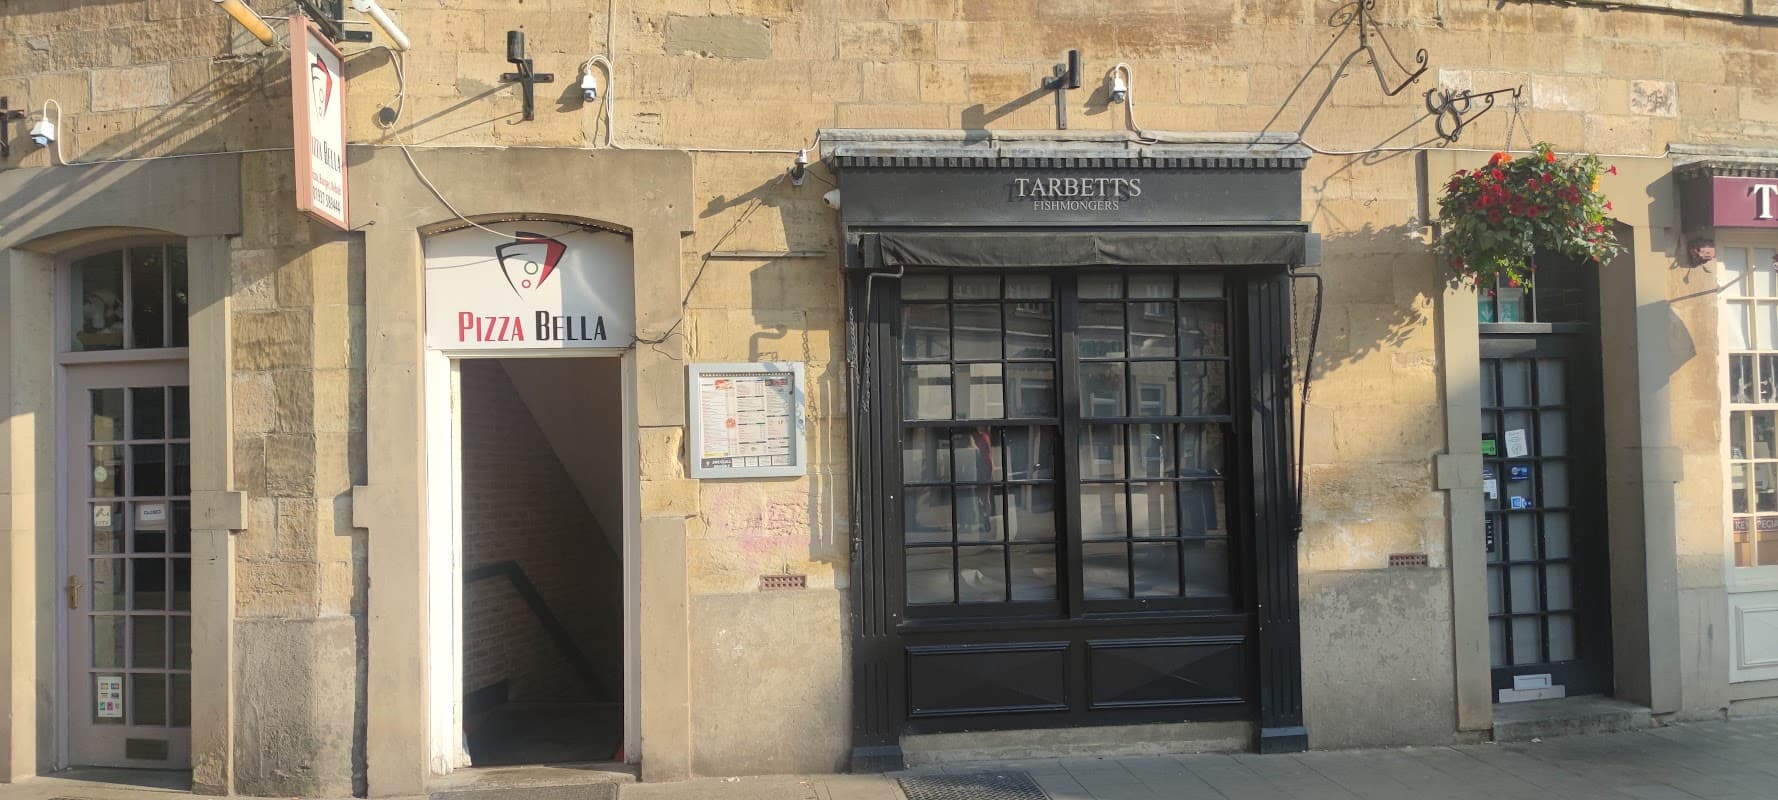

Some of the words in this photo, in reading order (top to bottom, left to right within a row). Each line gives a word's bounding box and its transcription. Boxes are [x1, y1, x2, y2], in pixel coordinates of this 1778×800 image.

[324, 141, 341, 173] BELLA
[1034, 201, 1119, 211] FISHMONGERS
[458, 311, 525, 342] PIZZA
[535, 310, 608, 341] BELLA
